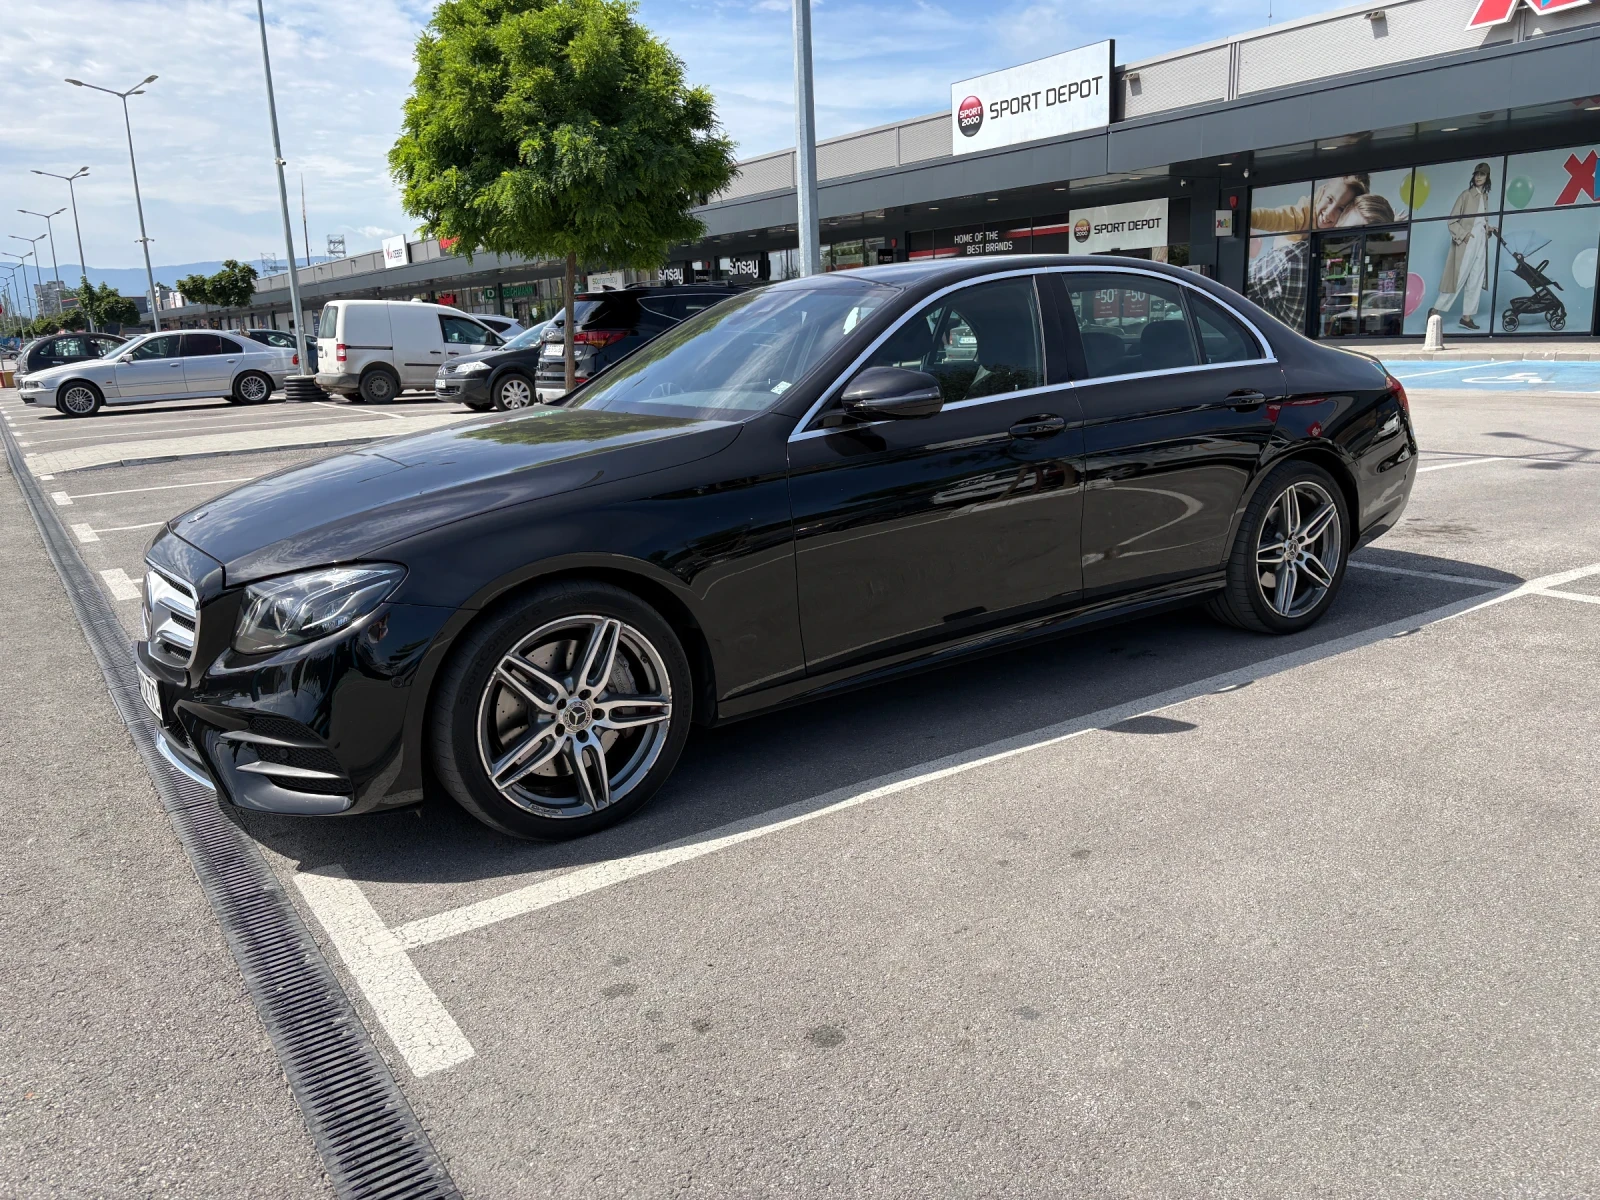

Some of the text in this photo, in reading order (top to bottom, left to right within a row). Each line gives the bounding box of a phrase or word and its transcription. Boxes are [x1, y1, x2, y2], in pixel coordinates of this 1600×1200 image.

[989, 75, 1103, 119] SPORT DEPOT
[959, 106, 982, 119] SPORT
[961, 116, 980, 126] 2000
[1093, 217, 1162, 235] SPORT DEPOT
[954, 231, 999, 244] HOME OF THE
[966, 241, 1013, 255] BEST BRANDS
[728, 258, 759, 279] sinsay
[658, 266, 683, 285] sinsay
[487, 289, 495, 298] D
[502, 285, 533, 297] DEICHMANN
